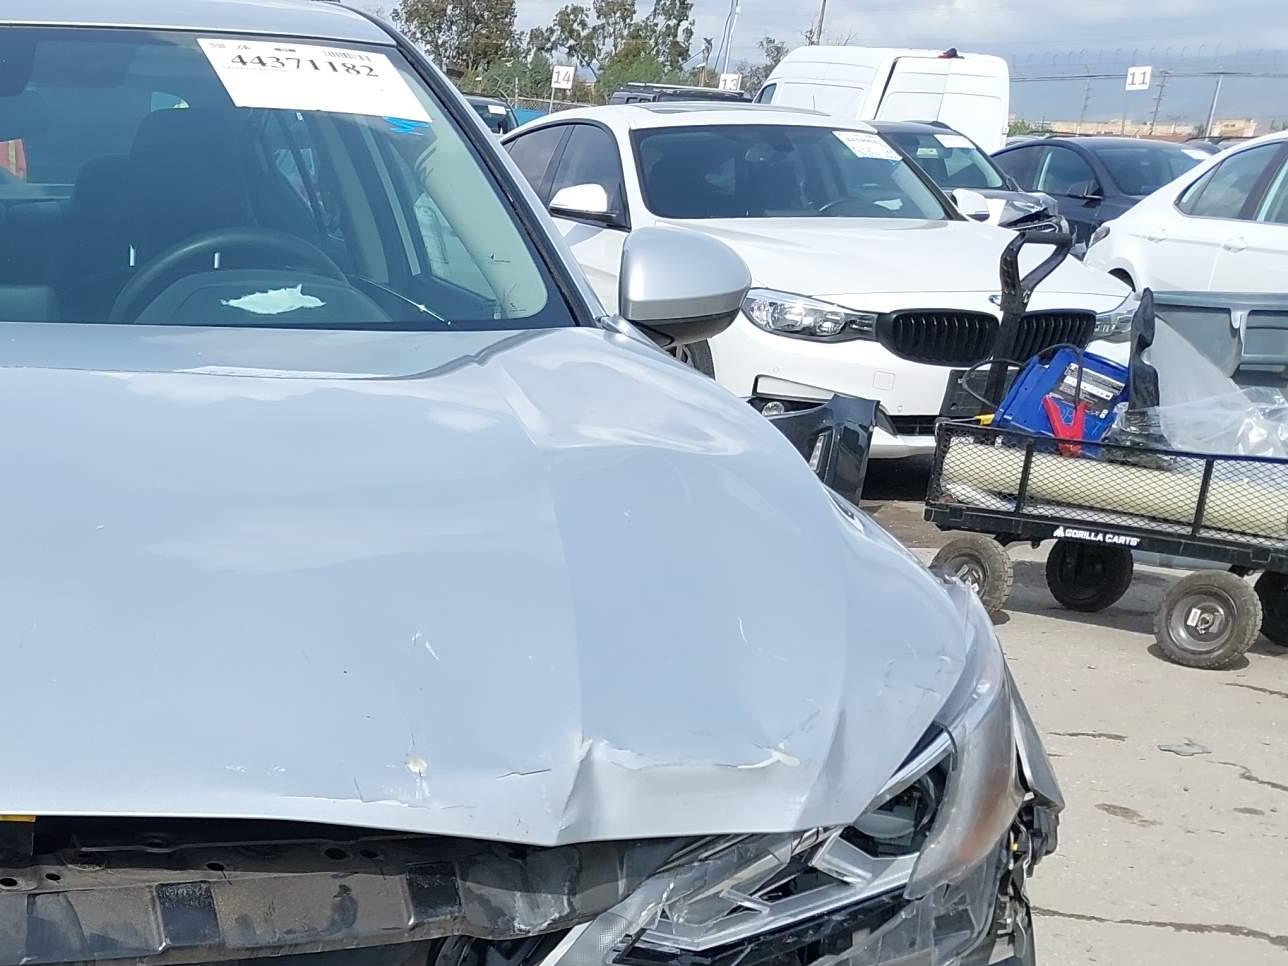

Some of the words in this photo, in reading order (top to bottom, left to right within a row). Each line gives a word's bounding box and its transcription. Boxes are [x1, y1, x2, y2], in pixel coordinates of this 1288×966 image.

[231, 54, 379, 77] 44371182
[553, 71, 571, 84] 14
[1128, 72, 1147, 85] 11
[1065, 529, 1103, 541] GORILLA
